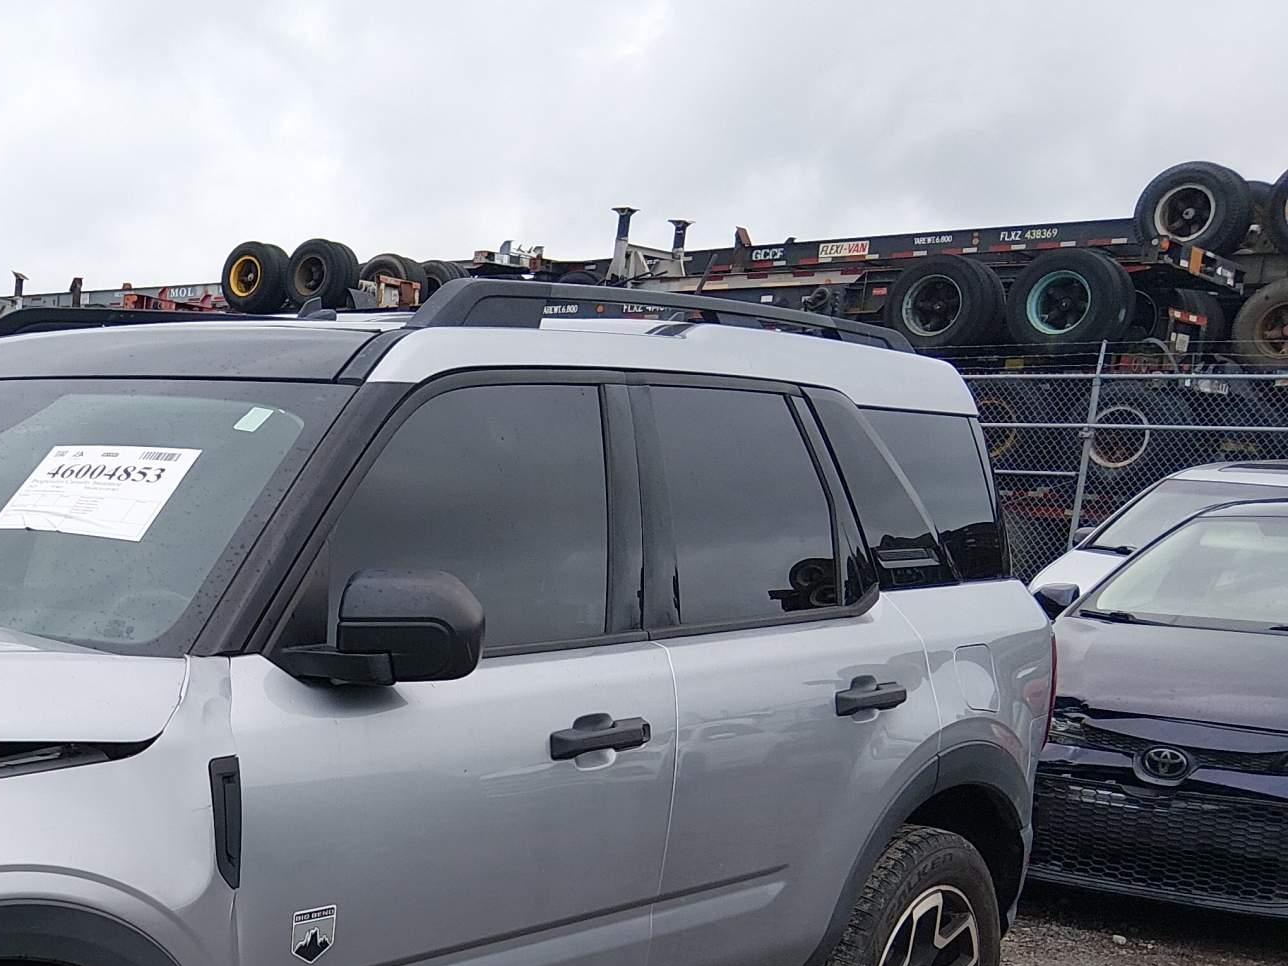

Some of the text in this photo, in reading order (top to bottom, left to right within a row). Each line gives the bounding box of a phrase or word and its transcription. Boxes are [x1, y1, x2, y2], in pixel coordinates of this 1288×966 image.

[1000, 228, 1058, 241] FLXZ 438369
[819, 242, 868, 256] FLEXI-VAN
[170, 287, 194, 297] MOL
[45, 463, 166, 484] 46004853
[311, 909, 334, 918] BEND
